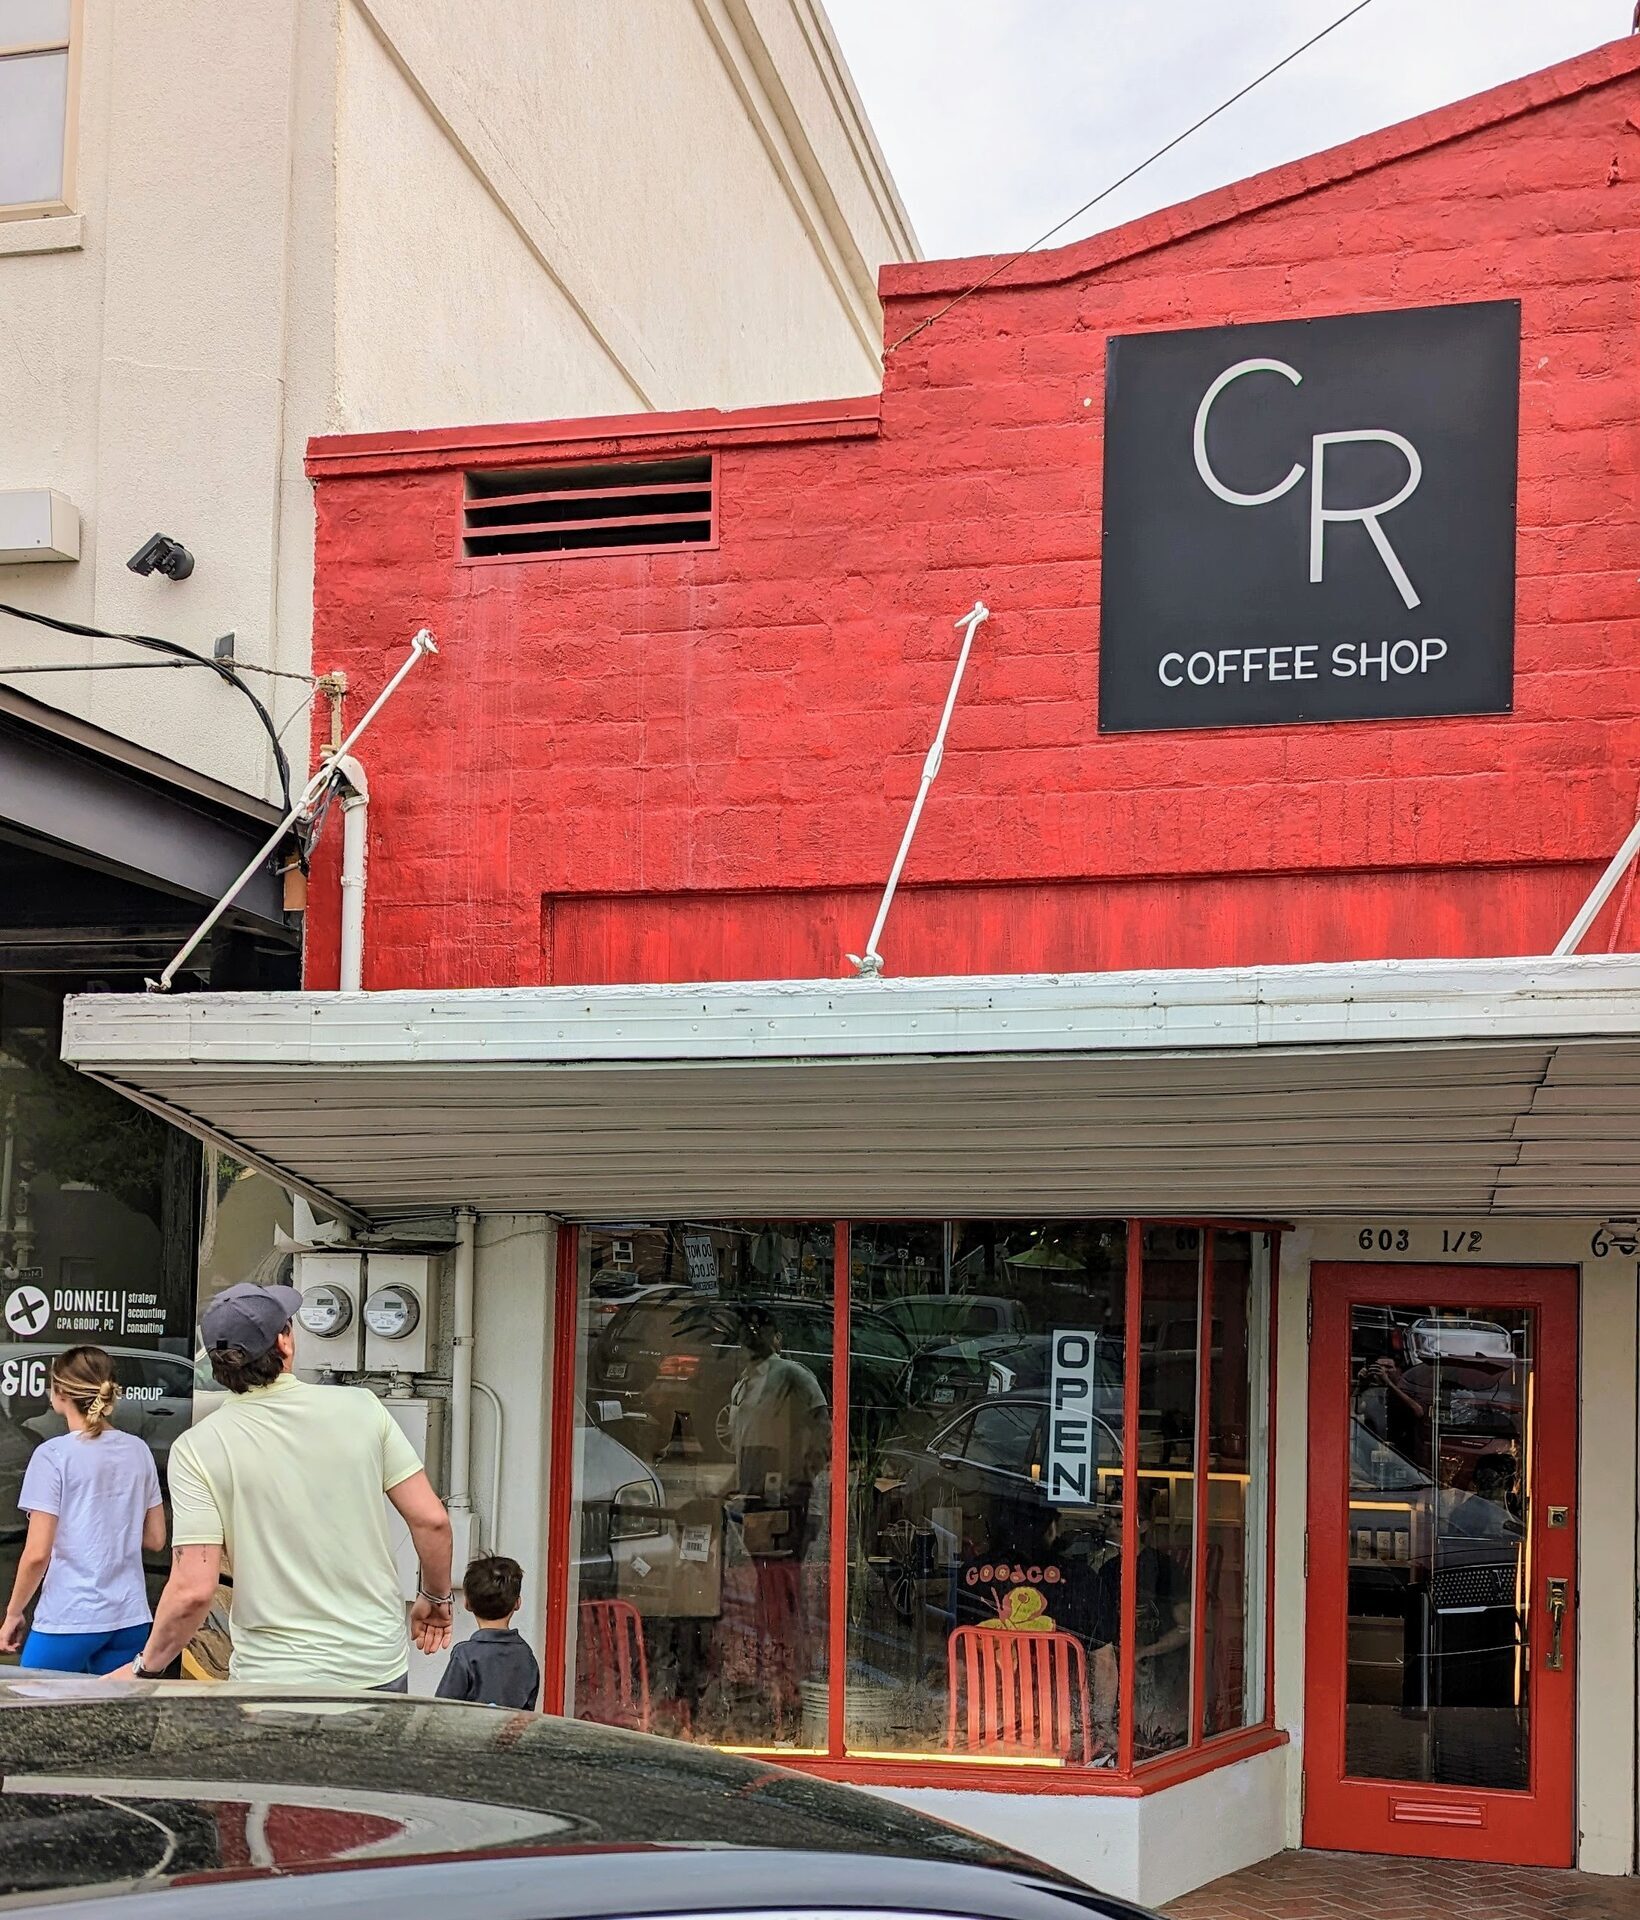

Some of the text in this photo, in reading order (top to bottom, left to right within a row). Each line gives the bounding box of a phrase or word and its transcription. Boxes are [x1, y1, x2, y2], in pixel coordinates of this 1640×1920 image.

[1193, 357, 1423, 610] CR
[1158, 638, 1448, 688] COFFEE SHOP
[1358, 1228, 1483, 1253] 603 1/2
[54, 1289, 119, 1313] DONNELL
[128, 1293, 157, 1305] strategy
[127, 1308, 167, 1321] accounting
[56, 1317, 114, 1332] CPA GROUP, PC
[126, 1322, 164, 1336] consulting
[125, 1386, 164, 1401] GROUP
[1052, 1335, 1090, 1497] OPEN
